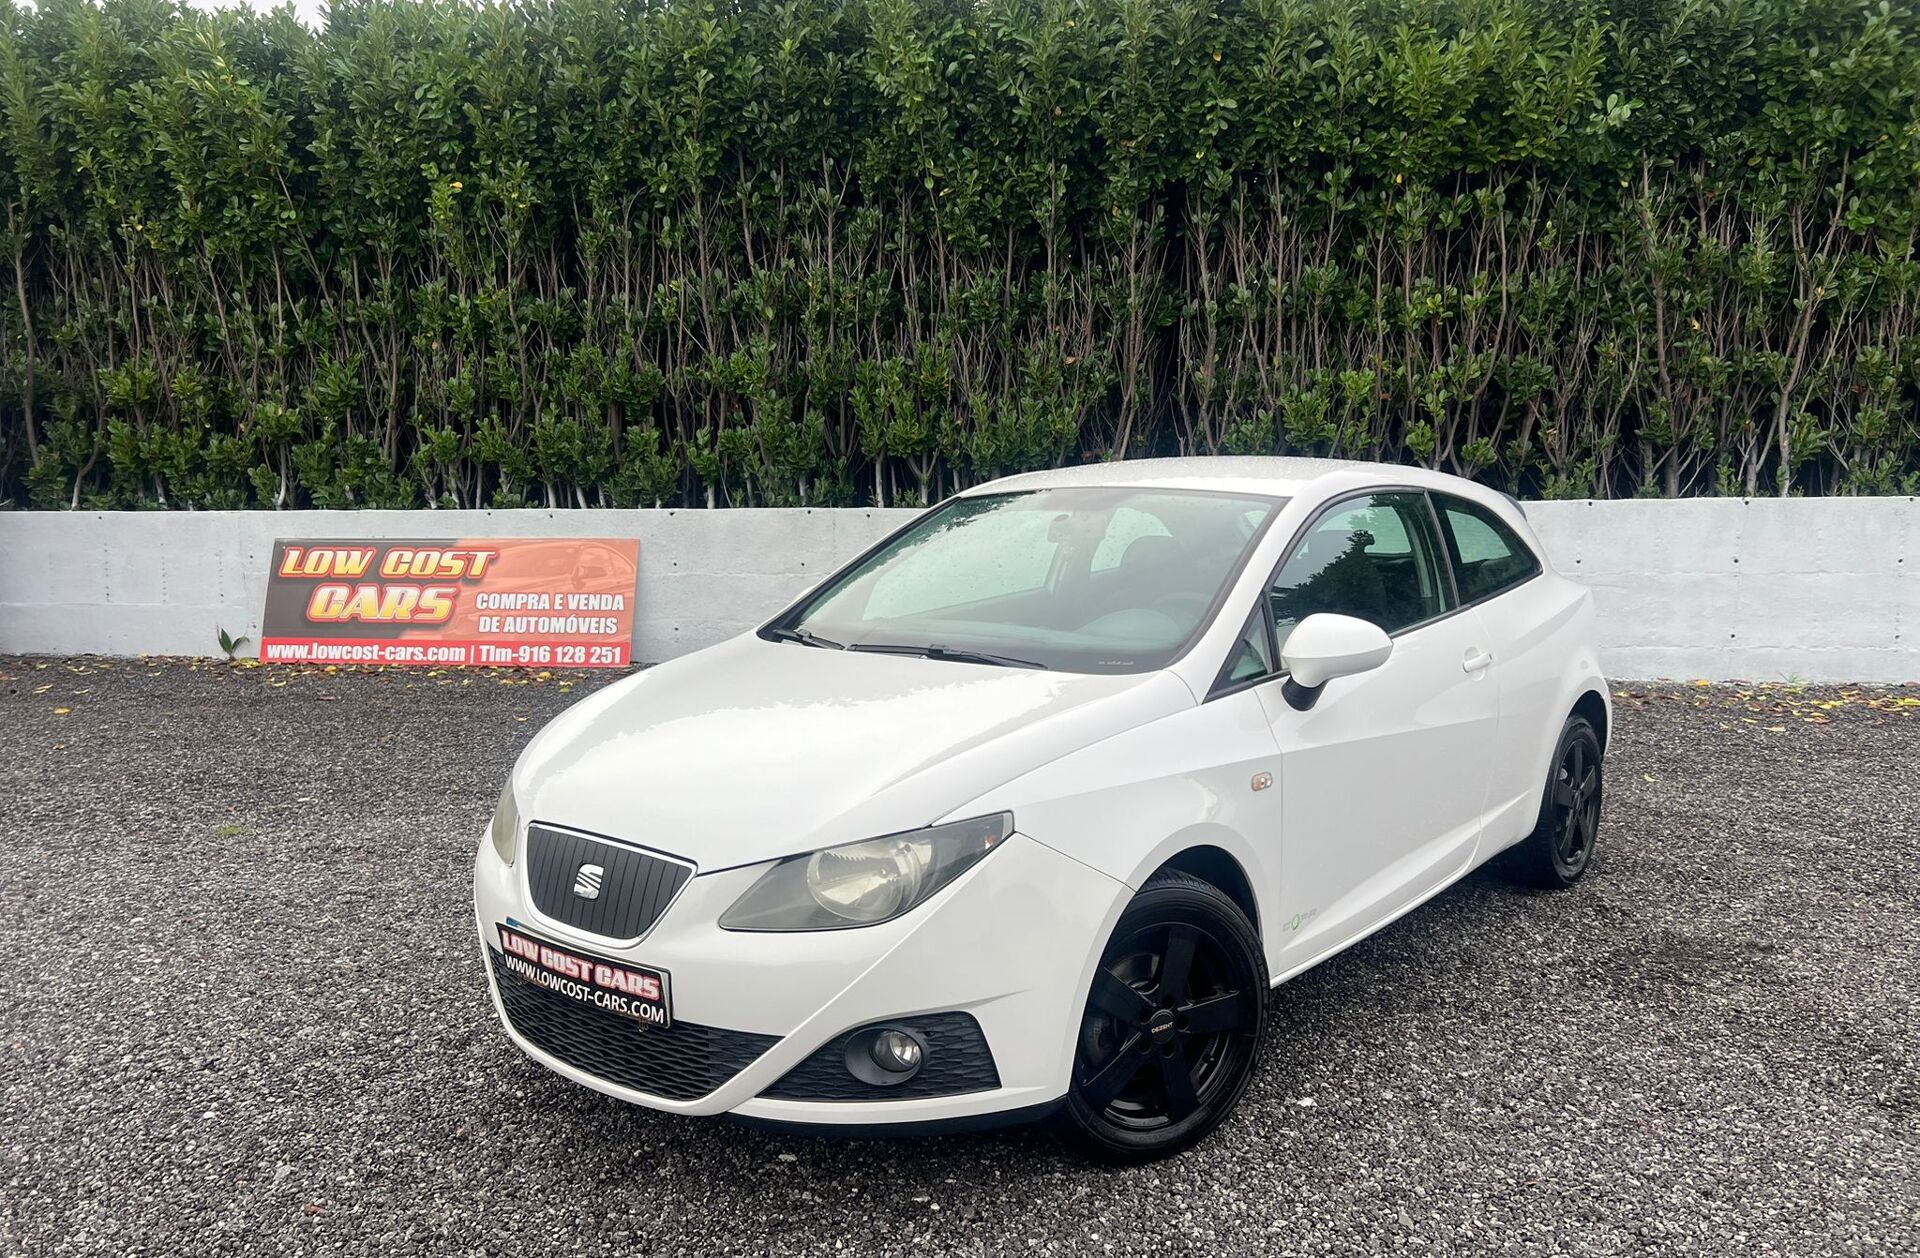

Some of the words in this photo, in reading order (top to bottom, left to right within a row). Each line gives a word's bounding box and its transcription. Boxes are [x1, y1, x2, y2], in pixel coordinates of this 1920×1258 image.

[280, 548, 375, 576] LOW
[380, 549, 496, 577] COST
[308, 584, 459, 621] CARS
[476, 593, 550, 610] COMPRA
[554, 593, 564, 610] E
[567, 594, 625, 611] VENDA
[478, 616, 500, 633] DE
[503, 613, 618, 634] AUTOMÓVEIS
[267, 642, 466, 662] www.lowcost-cars.com
[554, 646, 586, 664] 128
[589, 646, 621, 664] 251
[501, 929, 539, 962] LOW
[540, 946, 594, 982] COST
[594, 964, 660, 1001] CARS
[504, 954, 664, 1024] WWW.LOWCOST-CARS.COM
